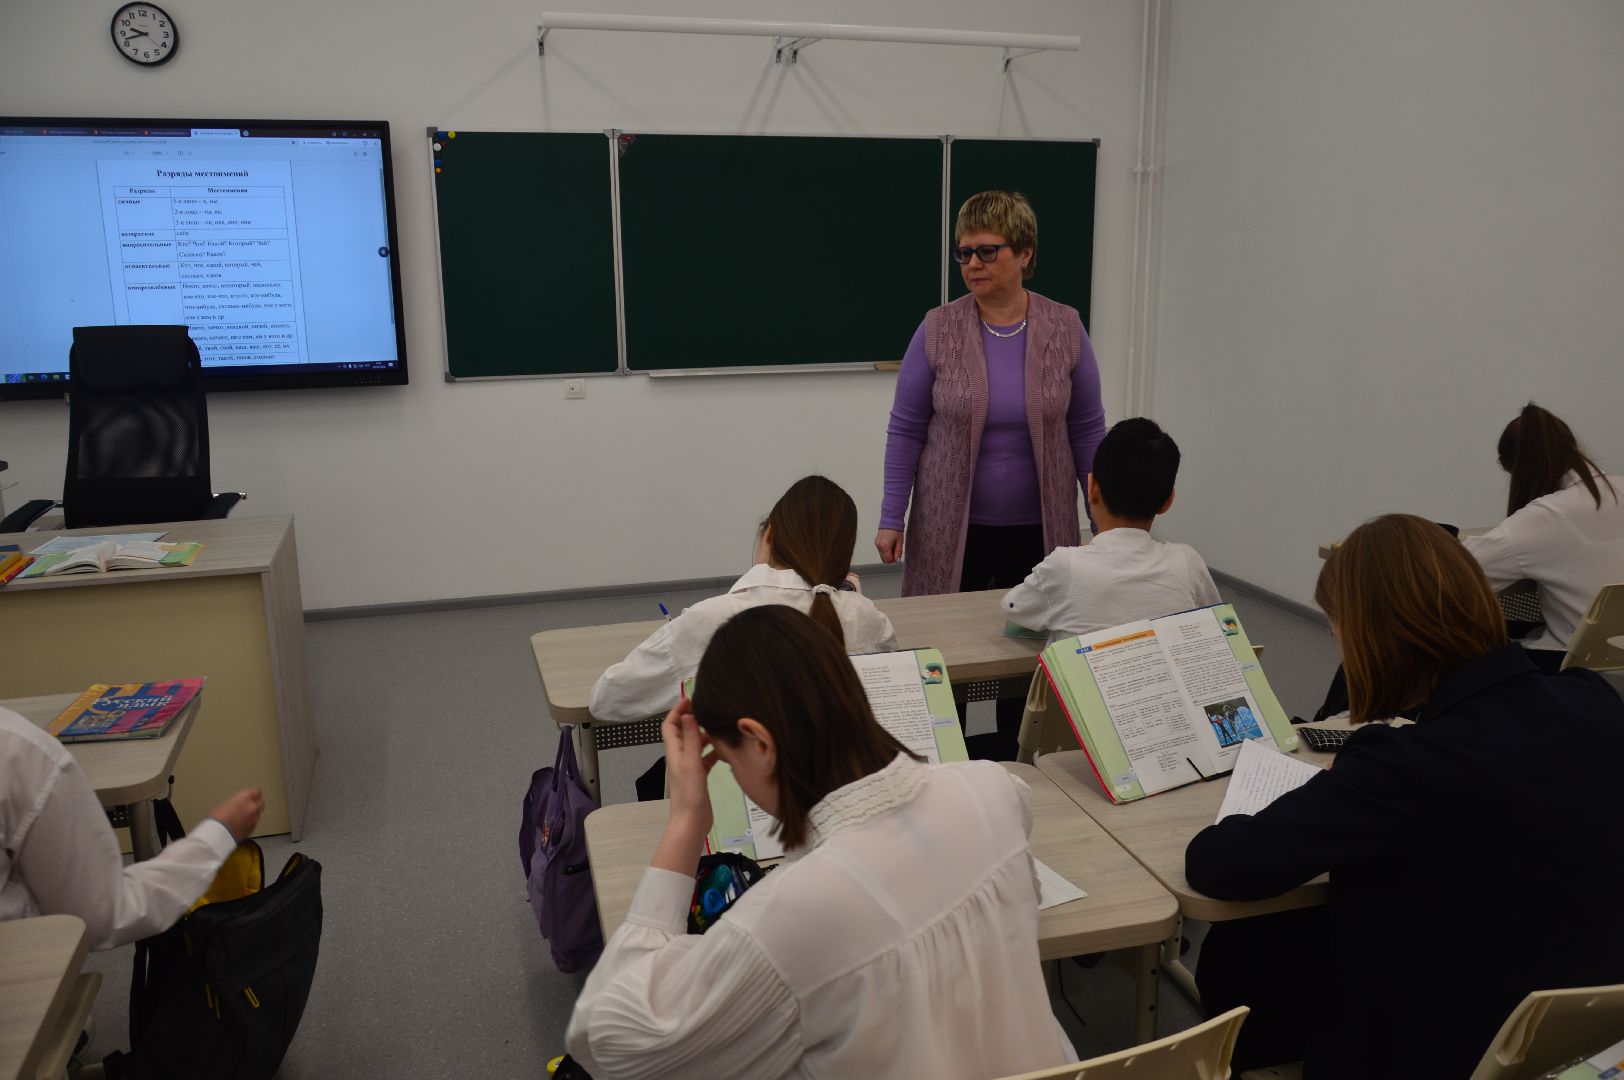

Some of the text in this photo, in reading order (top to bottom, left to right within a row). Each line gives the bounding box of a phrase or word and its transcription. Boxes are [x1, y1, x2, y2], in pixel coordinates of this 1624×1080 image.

[156, 170, 249, 178] Разряды местоимений
[92, 695, 172, 706] Русский
